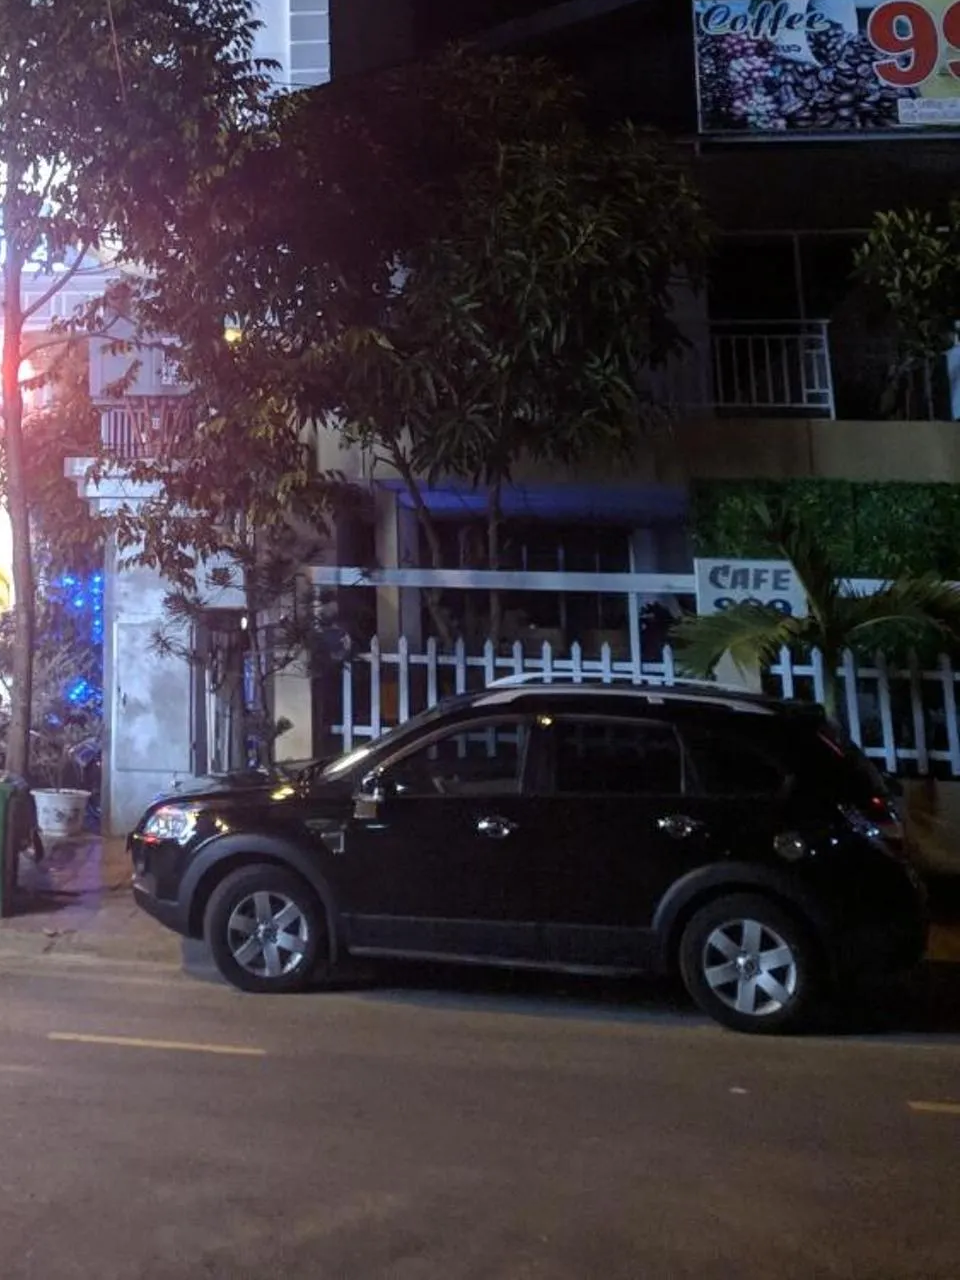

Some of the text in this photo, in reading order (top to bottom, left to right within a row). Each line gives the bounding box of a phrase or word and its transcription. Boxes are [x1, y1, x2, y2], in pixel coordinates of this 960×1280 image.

[701, 0, 960, 88] Coffee 9
[708, 564, 792, 591] CAFE
